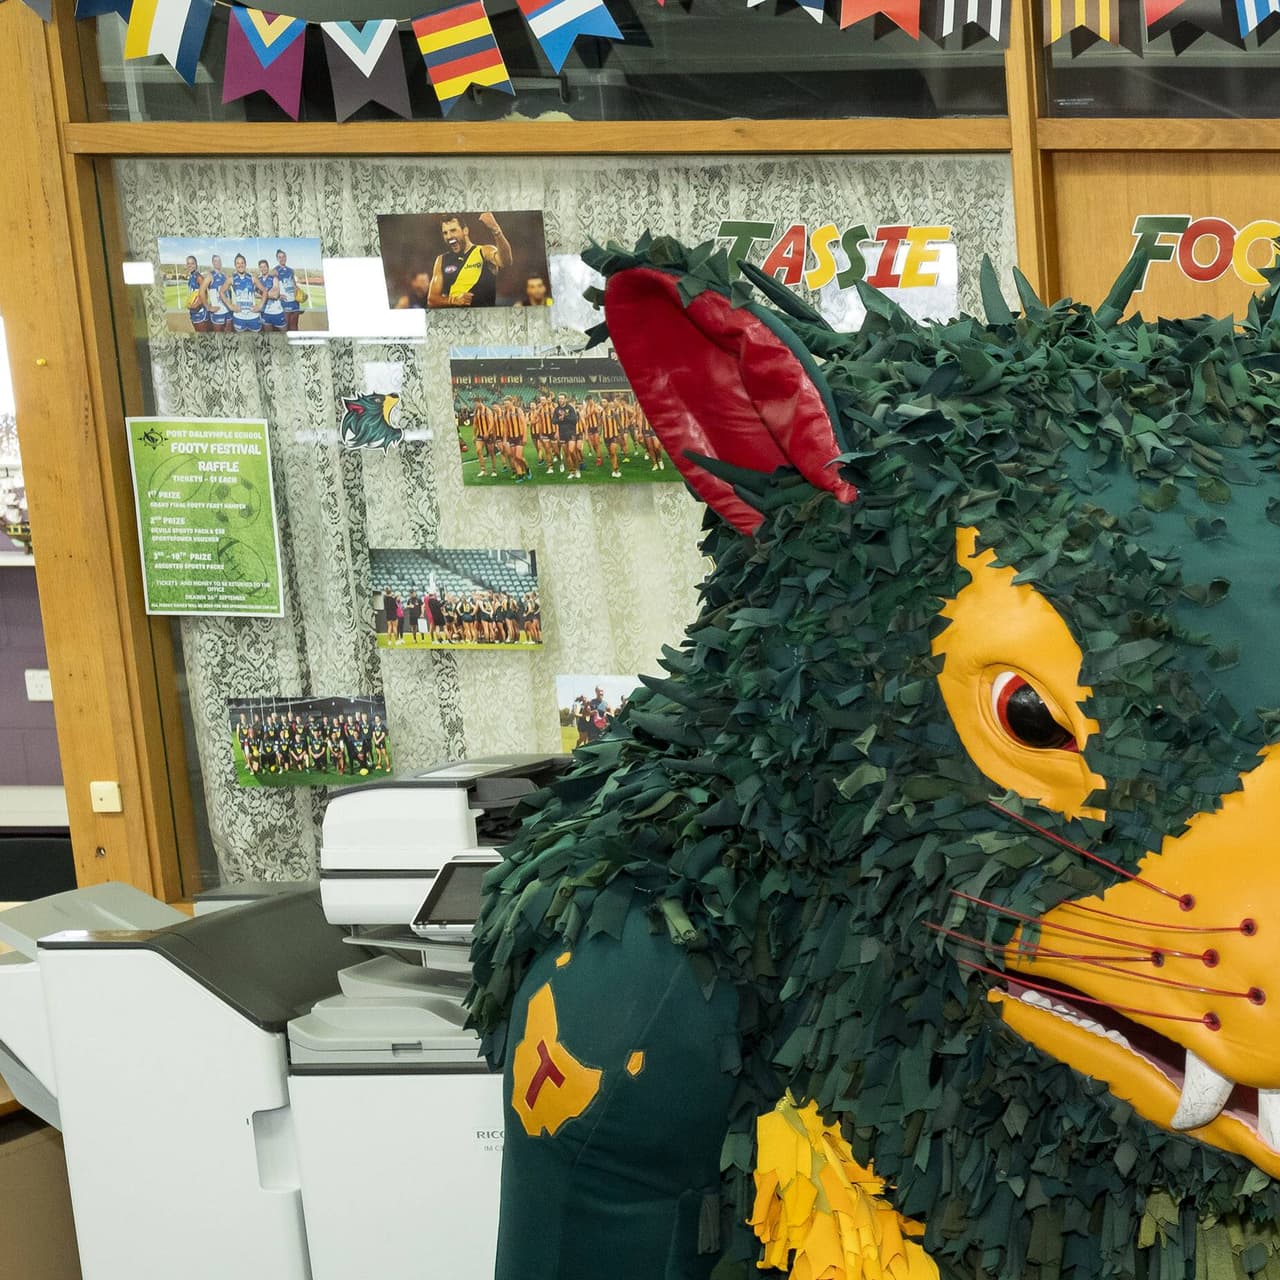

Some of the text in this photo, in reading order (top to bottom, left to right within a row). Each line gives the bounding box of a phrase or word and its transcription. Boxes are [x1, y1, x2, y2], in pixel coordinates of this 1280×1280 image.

[717, 220, 951, 290] TASSIE
[234, 431, 262, 440] SCHOOL
[170, 442, 261, 455] FOOTY FESTIVAL
[198, 461, 239, 473] RAFFLE
[158, 491, 181, 499] PRIZE
[163, 517, 185, 525] PRIZE
[190, 553, 212, 561] PRIZE
